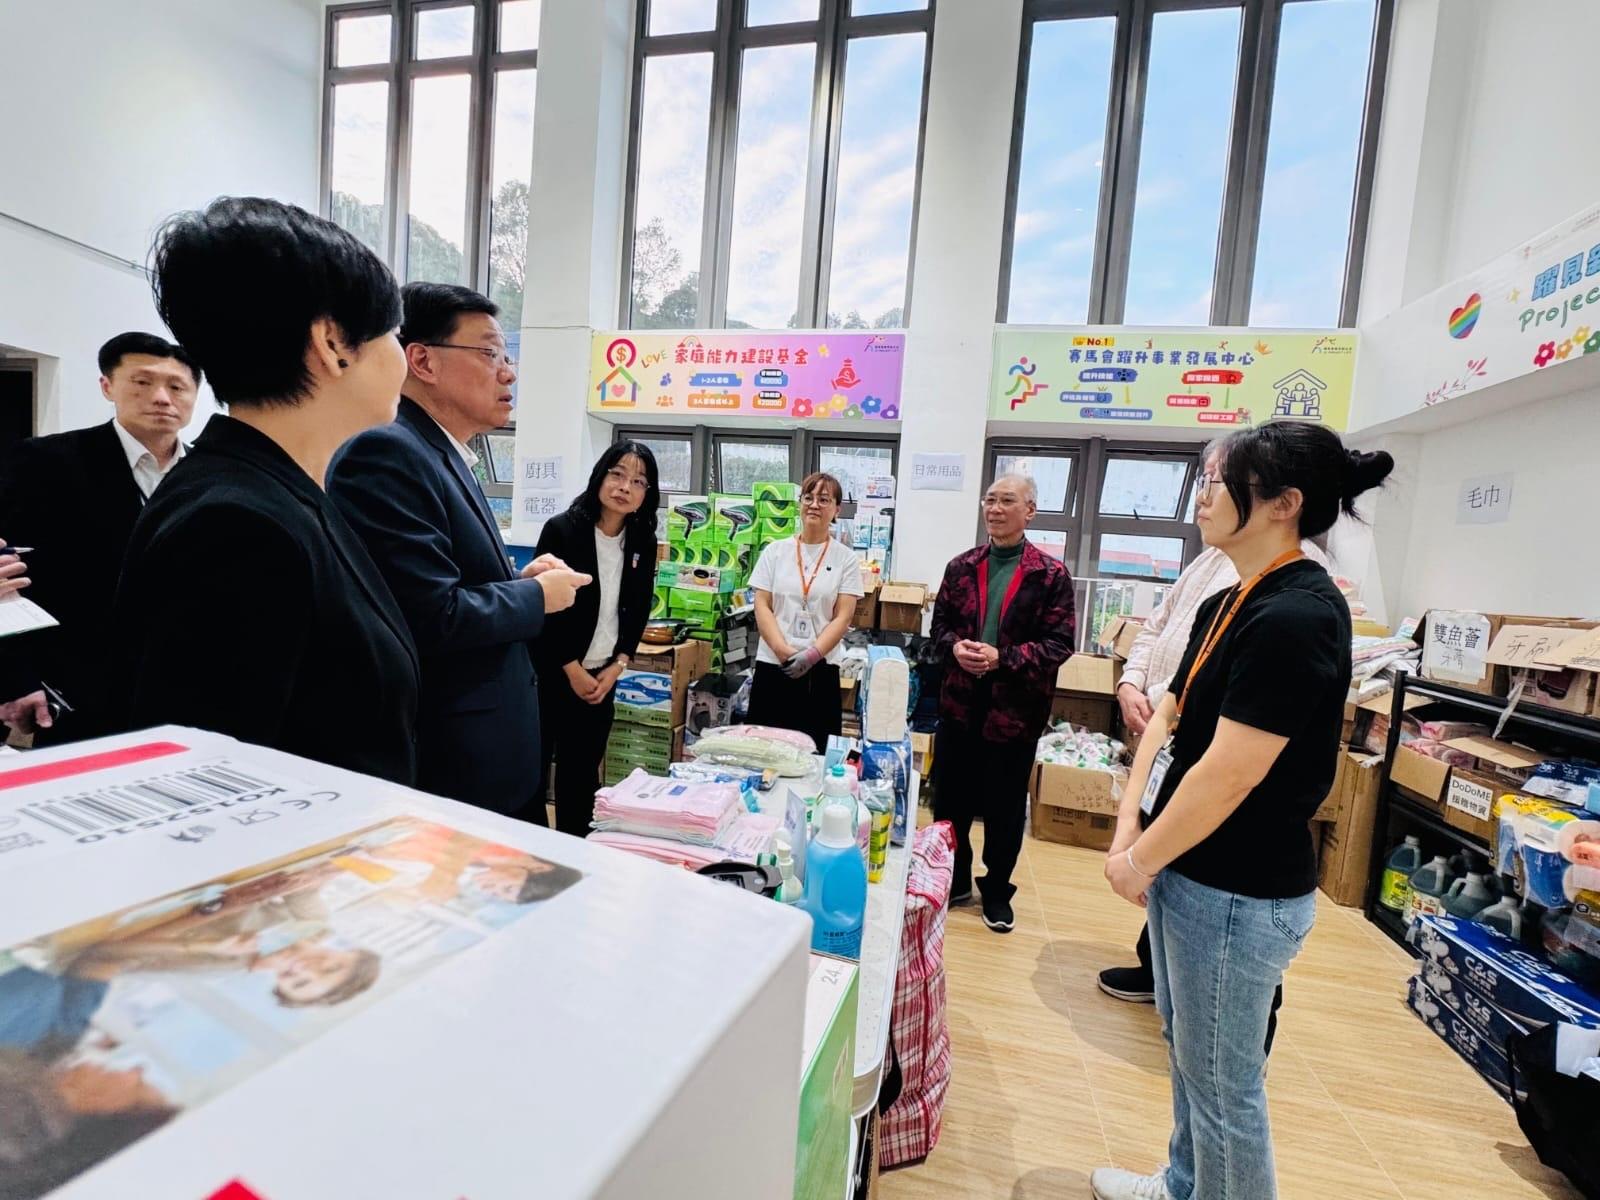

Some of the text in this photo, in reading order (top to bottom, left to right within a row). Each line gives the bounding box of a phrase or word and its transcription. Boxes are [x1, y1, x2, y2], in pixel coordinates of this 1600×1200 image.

[641, 350, 667, 368] LOVE
[674, 348, 808, 364] 家庭能力建設基金
[1069, 349, 1254, 365] 賽馬會躍升事業發展中心
[526, 462, 558, 479] 廚具
[914, 464, 962, 477] 日常用品
[524, 496, 558, 514] 電器
[1466, 485, 1500, 508] 毛巾
[1432, 622, 1481, 649] 雙魚薈
[1452, 779, 1491, 801] DoDoME
[1465, 956, 1497, 986] C&S
[1465, 991, 1492, 1021] C&S
[1452, 1019, 1479, 1050] C&S
